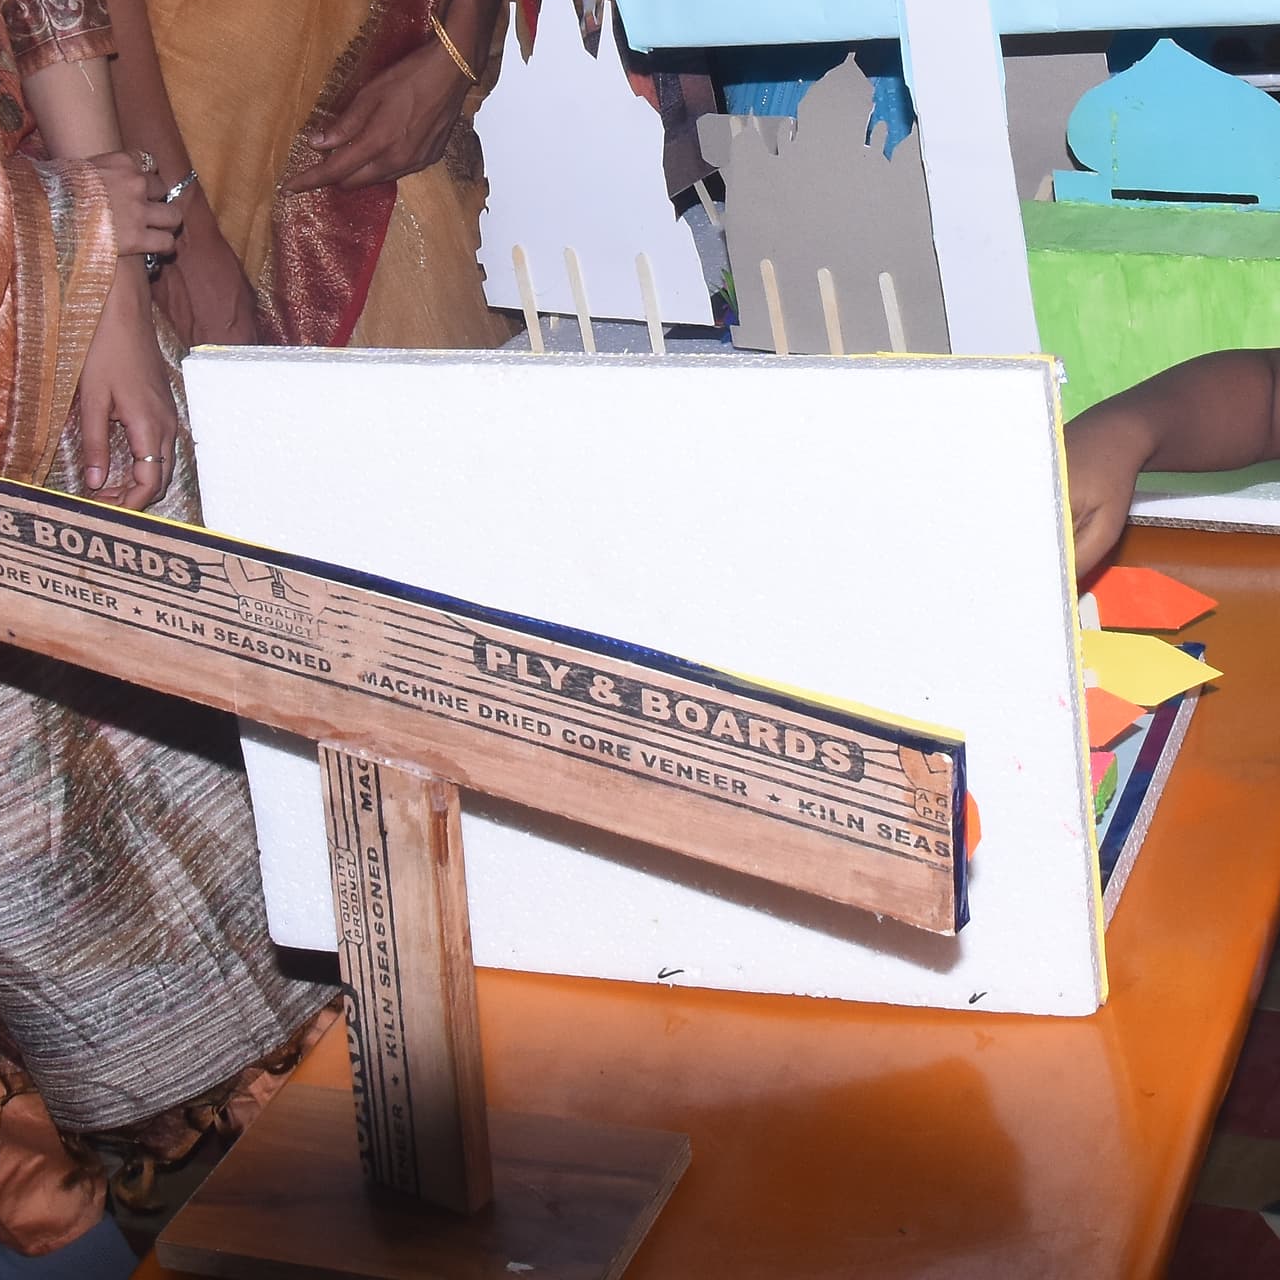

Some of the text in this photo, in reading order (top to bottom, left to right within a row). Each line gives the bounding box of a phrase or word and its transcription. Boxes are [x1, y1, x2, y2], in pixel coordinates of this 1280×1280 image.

[34, 520, 194, 586] BOARDS
[37, 574, 120, 611] VENEER
[155, 610, 206, 637] KILN
[213, 624, 334, 674] SEASONED
[238, 598, 314, 626] A QUALITY
[245, 610, 314, 639] PRODUCT
[484, 644, 855, 774] PLY & BOARDS
[361, 670, 950, 859] MACHINE DRIED CORE VENEER KILN SEAS
[917, 792, 930, 804] A
[337, 853, 350, 923] QUALITY
[347, 859, 361, 939] PRODUCT
[366, 846, 394, 988] SEASONED
[380, 996, 399, 1059] KILN
